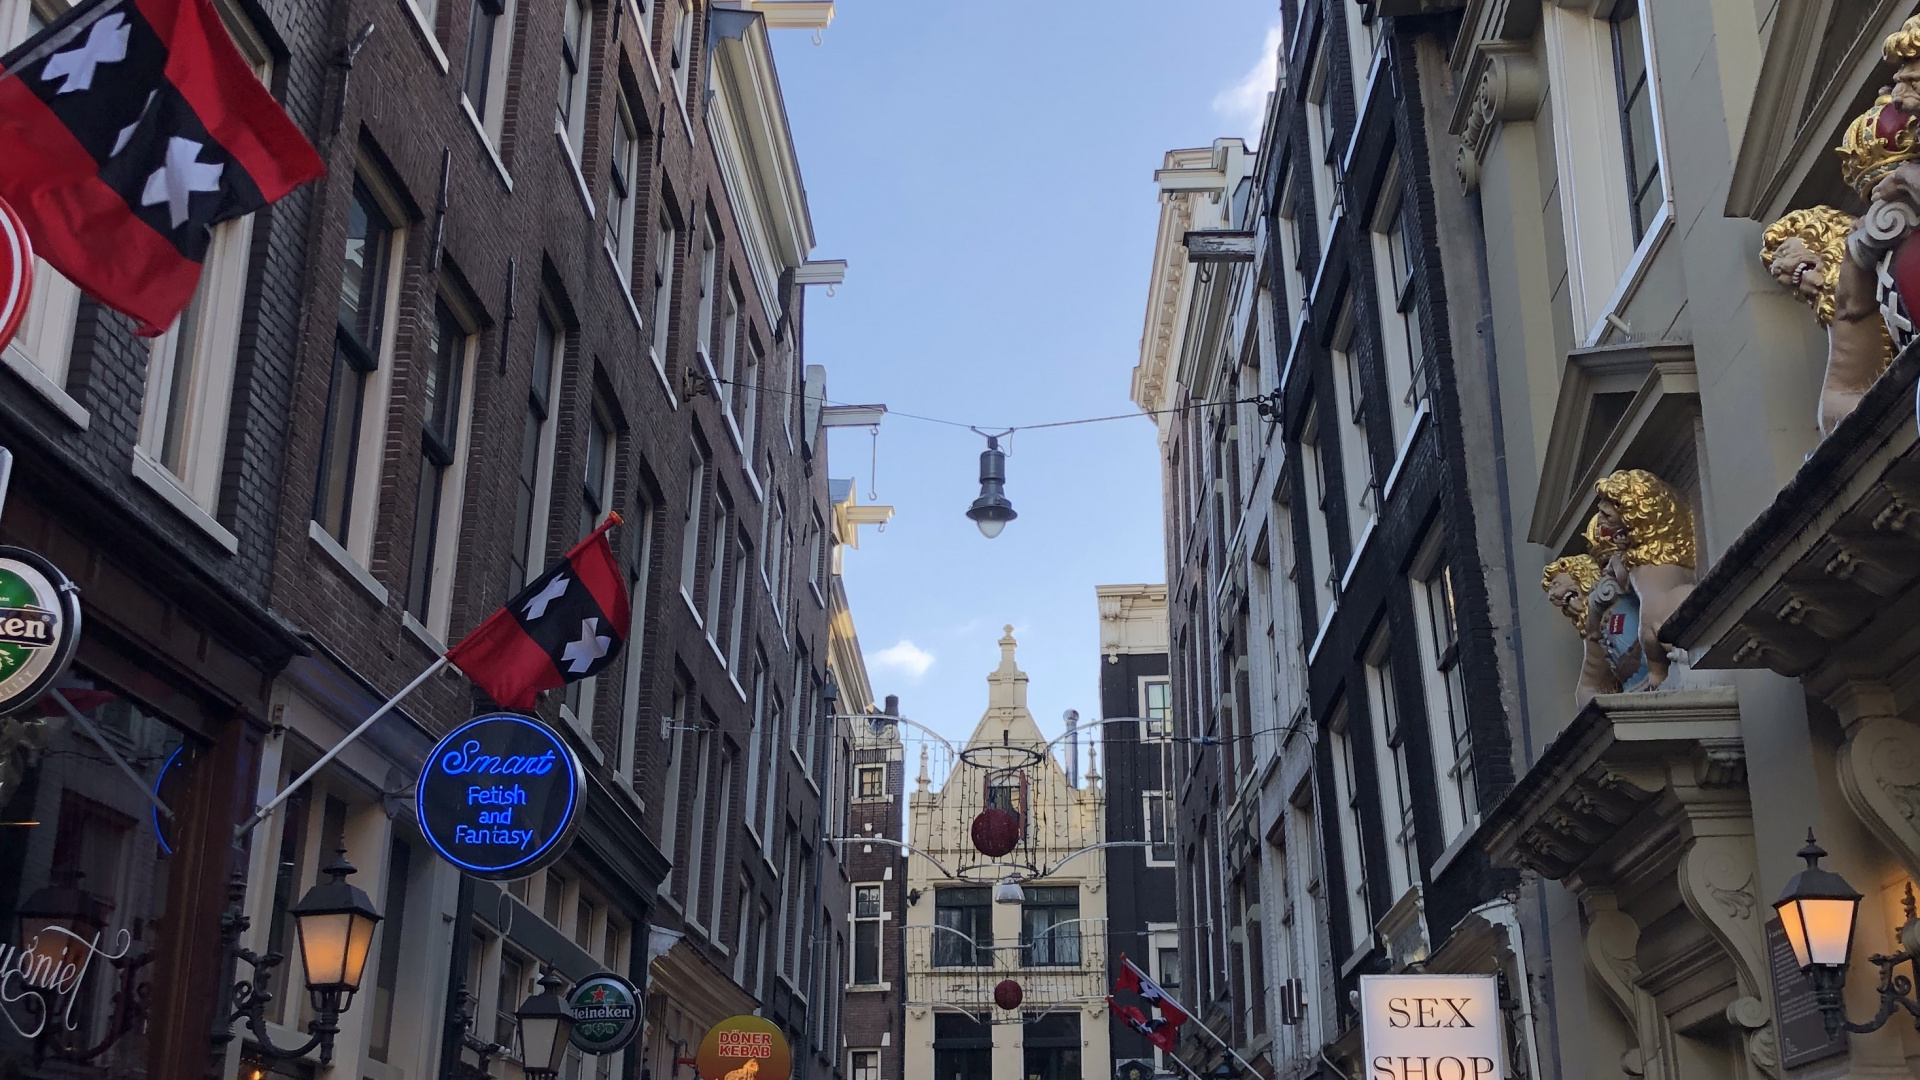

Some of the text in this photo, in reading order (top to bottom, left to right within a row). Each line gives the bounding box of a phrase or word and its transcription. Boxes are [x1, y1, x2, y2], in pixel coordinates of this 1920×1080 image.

[442, 740, 556, 775] Smart
[468, 784, 526, 805] Fetish
[479, 807, 512, 825] and
[455, 825, 534, 850] Fantasy
[571, 1006, 630, 1019] Heineken
[1388, 997, 1475, 1028] SEX
[719, 1029, 772, 1045] DÖNER
[719, 1044, 771, 1058] KEBAB
[1373, 1055, 1495, 1080] SHOP
